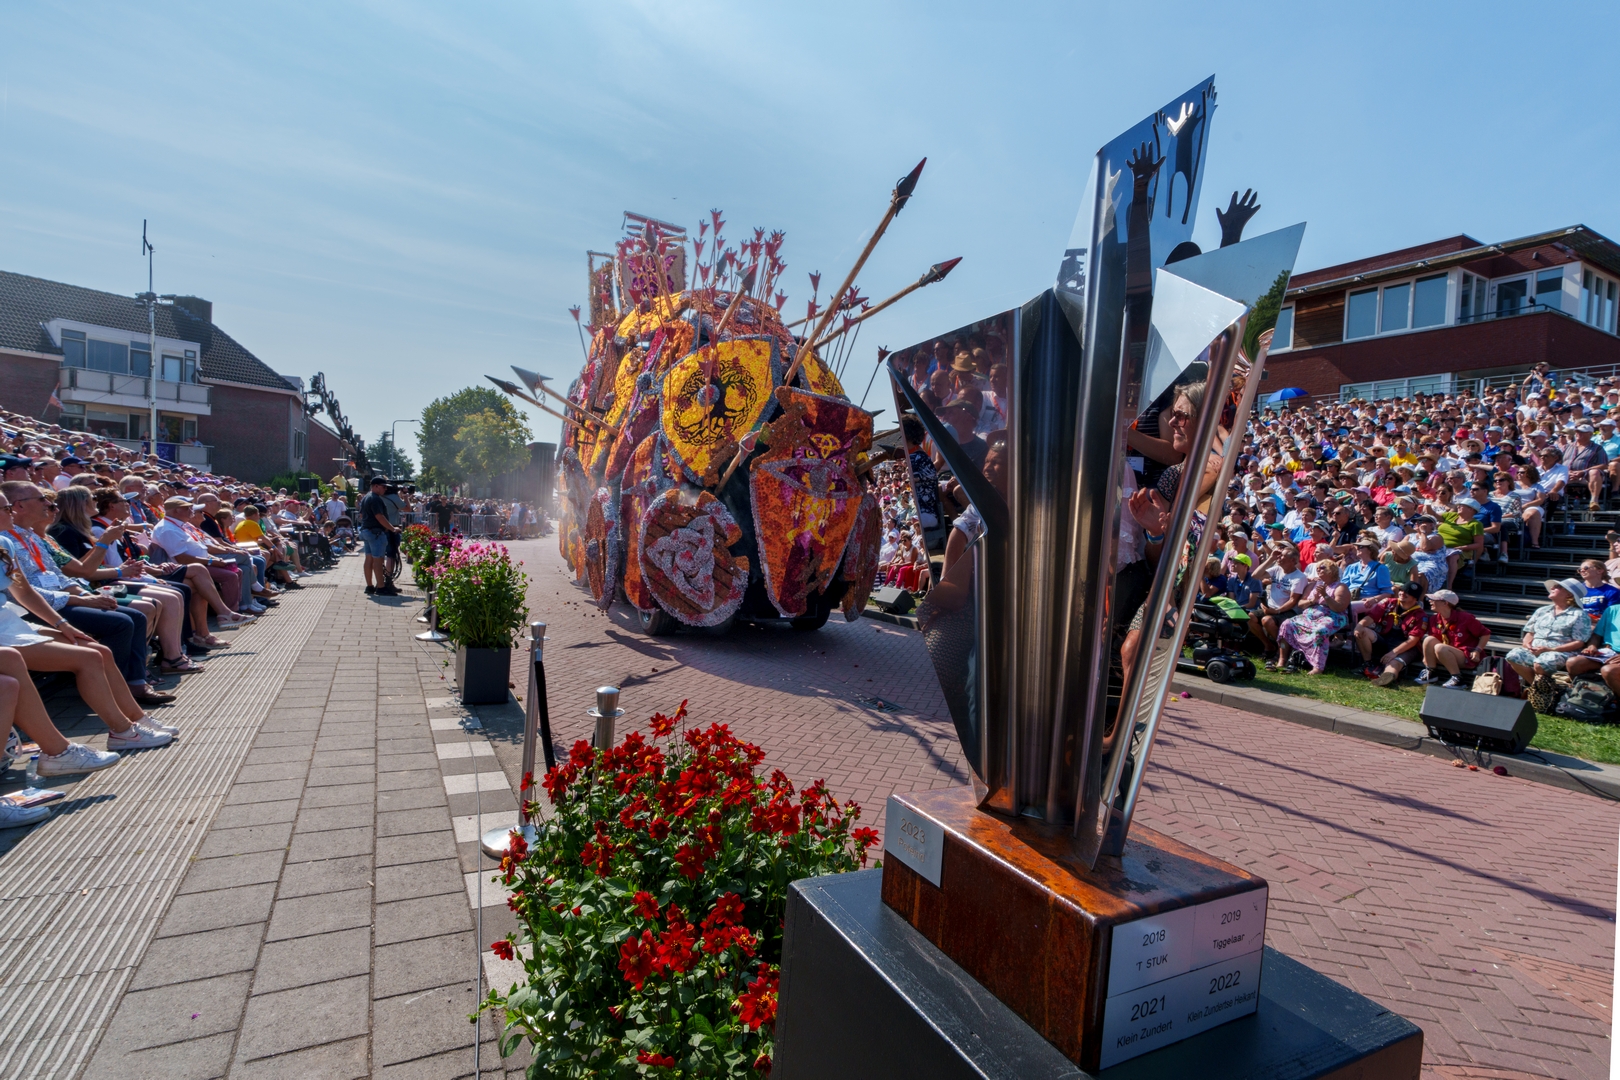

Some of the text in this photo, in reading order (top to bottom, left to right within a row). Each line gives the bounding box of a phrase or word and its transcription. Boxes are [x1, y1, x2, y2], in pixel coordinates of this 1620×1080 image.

[900, 818, 925, 844] 2023
[1221, 910, 1241, 925] 2019
[1143, 930, 1165, 946] 2018
[1213, 934, 1245, 949] Tiggelaar
[1146, 954, 1168, 968] STUK
[1209, 970, 1240, 994] 2022
[1131, 995, 1165, 1021] 2021
[1187, 1010, 1203, 1023] Klein
[1117, 1020, 1172, 1048] Klein Zundert
